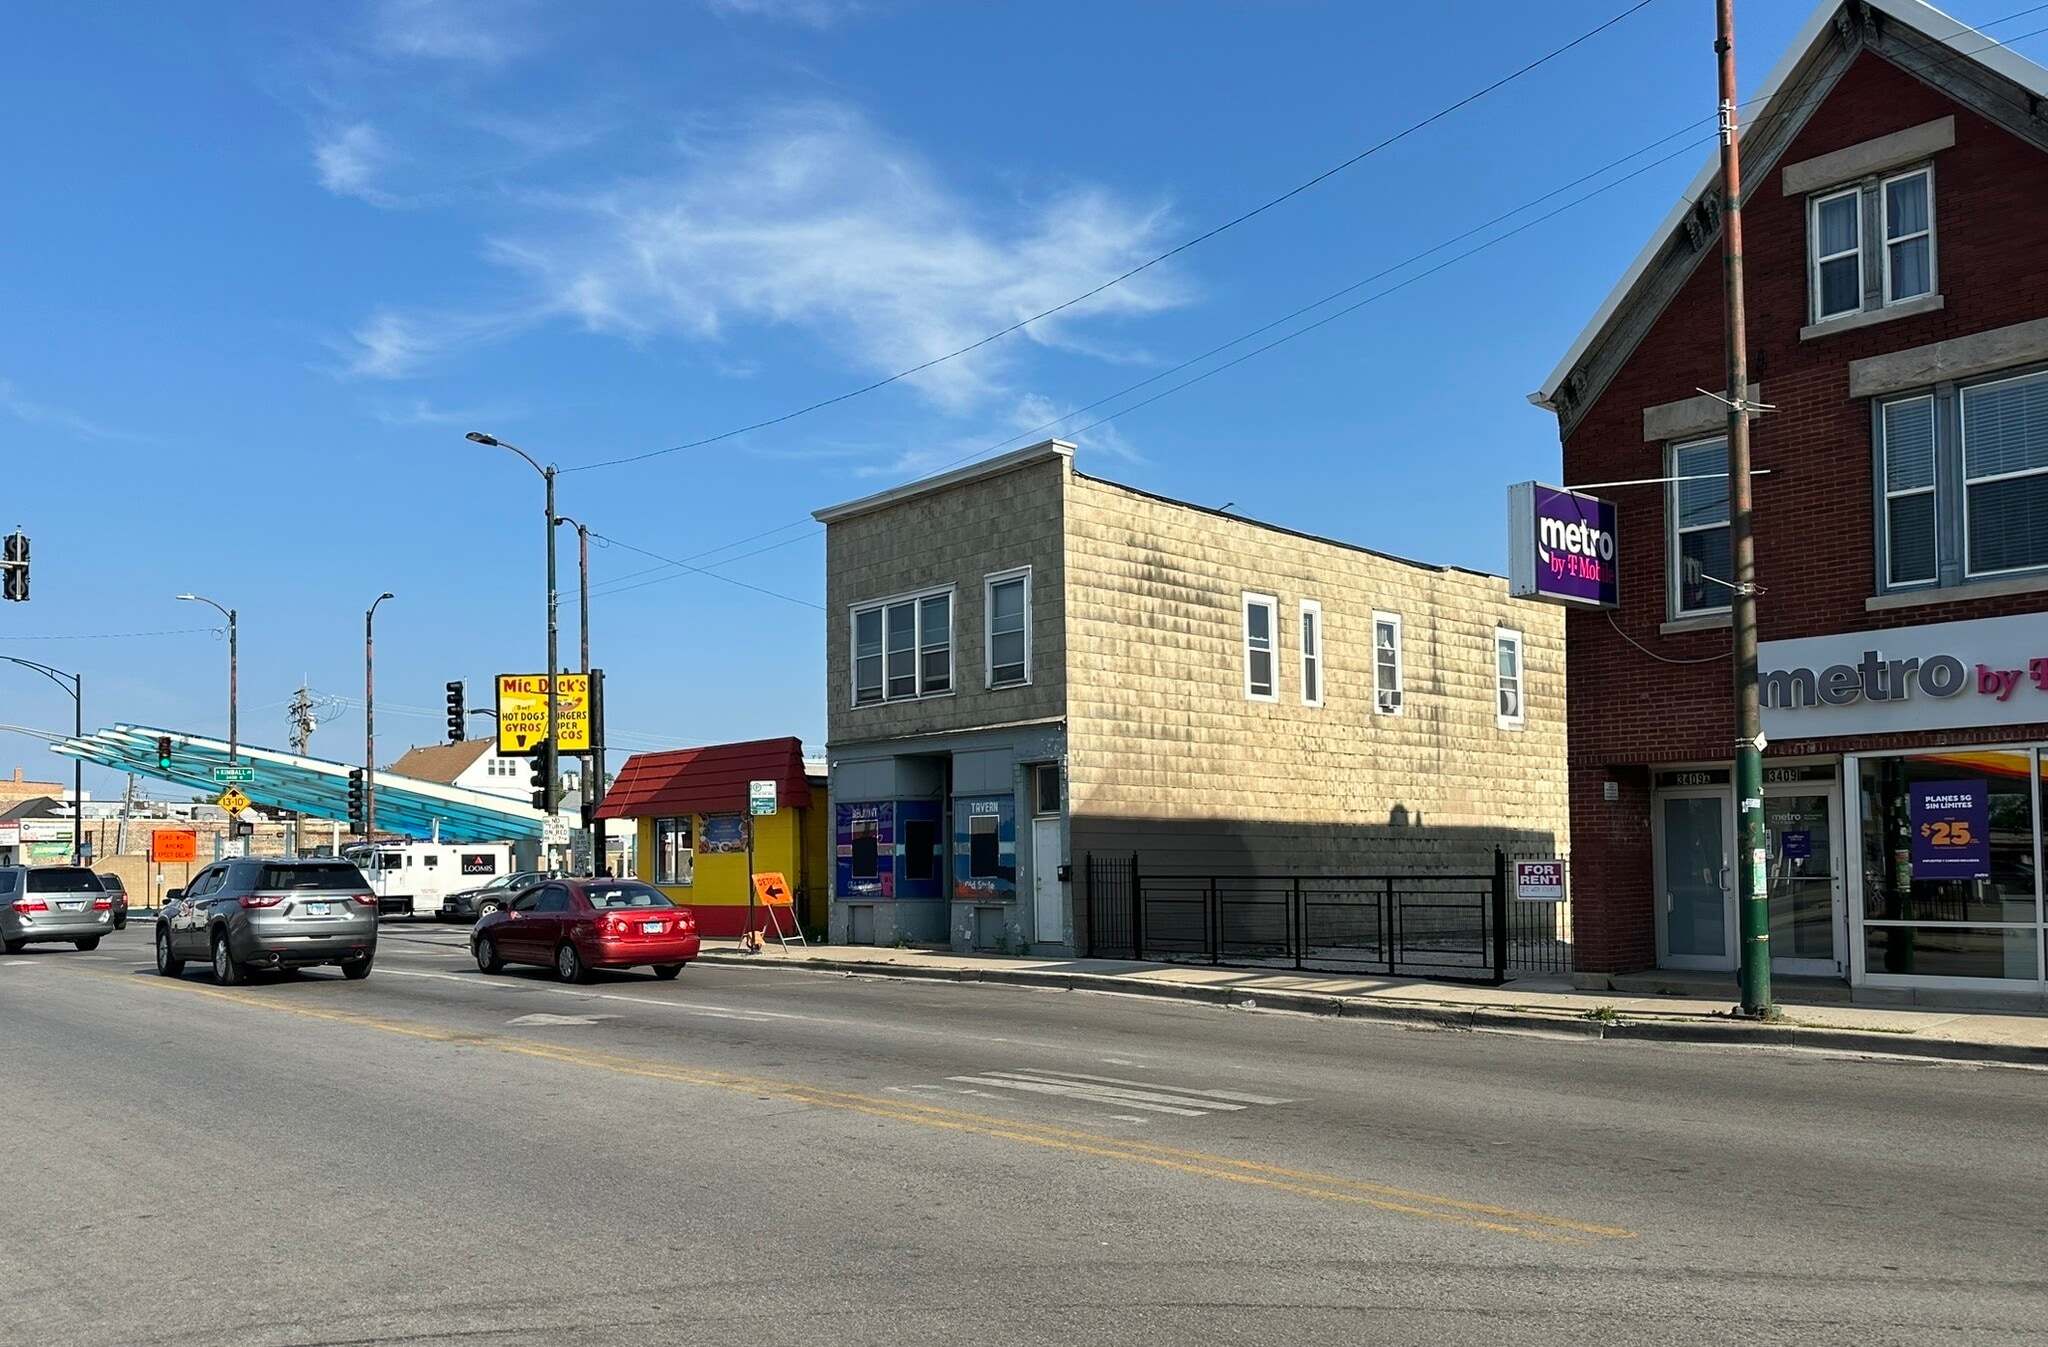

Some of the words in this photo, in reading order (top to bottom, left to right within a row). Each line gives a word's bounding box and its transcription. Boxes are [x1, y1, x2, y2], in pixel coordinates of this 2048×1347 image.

[1538, 517, 1613, 563] metro
[1551, 551, 1565, 579] by
[1758, 650, 1967, 709] metro
[1975, 664, 2023, 701] by
[503, 679, 531, 693] Mic
[538, 678, 586, 693] Dck's
[502, 712, 519, 721] HOT
[521, 712, 545, 721] DOGS
[556, 711, 587, 720] URGERS
[505, 723, 542, 732] GYROS
[555, 730, 583, 739] ACOS
[970, 801, 999, 813] TAVERN
[1772, 812, 1802, 821] metro
[1921, 822, 1971, 845] $25
[464, 864, 493, 873] LOOMIS
[1524, 865, 1555, 875] FOR
[1520, 875, 1560, 885] RENT
